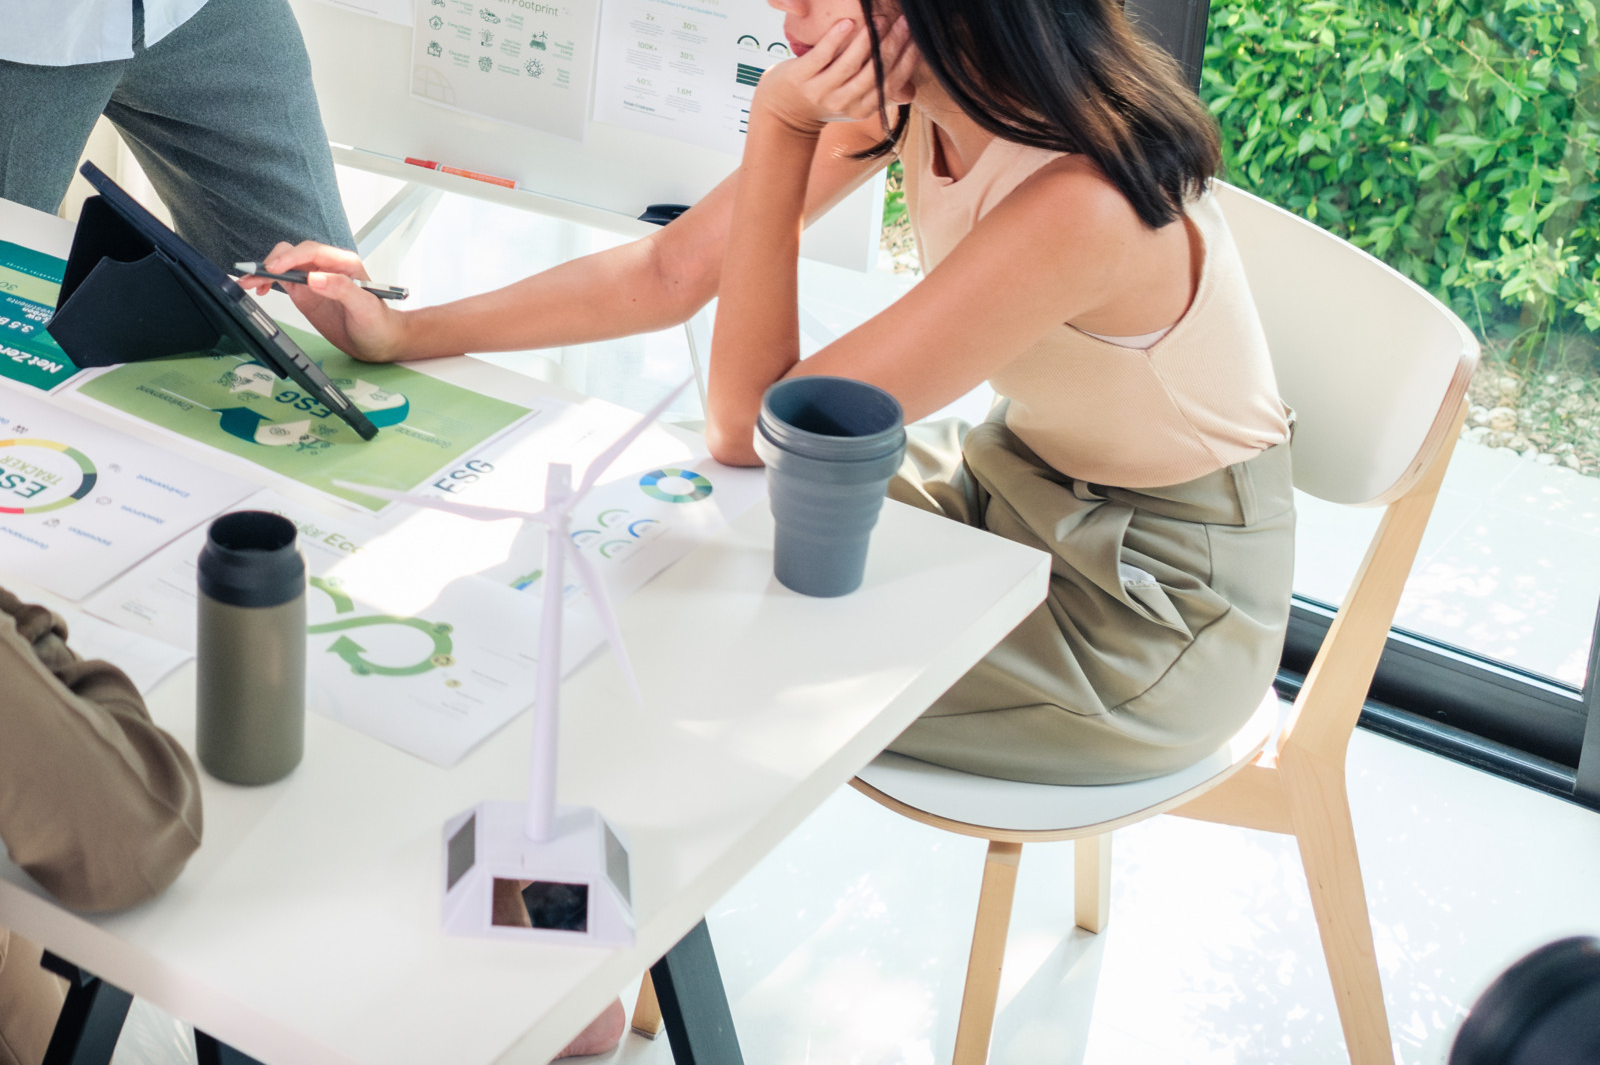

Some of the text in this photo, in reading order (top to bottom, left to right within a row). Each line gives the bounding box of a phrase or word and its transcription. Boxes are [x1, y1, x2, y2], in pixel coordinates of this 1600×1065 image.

[646, 13, 655, 22] 2x
[682, 22, 698, 32] 30%
[637, 41, 658, 52] 100K+
[679, 51, 695, 62] 30%
[24, 312, 48, 323] Low
[8, 318, 34, 333] 3.5
[27, 355, 64, 374] Net
[135, 384, 194, 412] Environment
[395, 426, 452, 449] Governance
[0, 454, 65, 486] TRACKER
[433, 459, 495, 494] ESG
